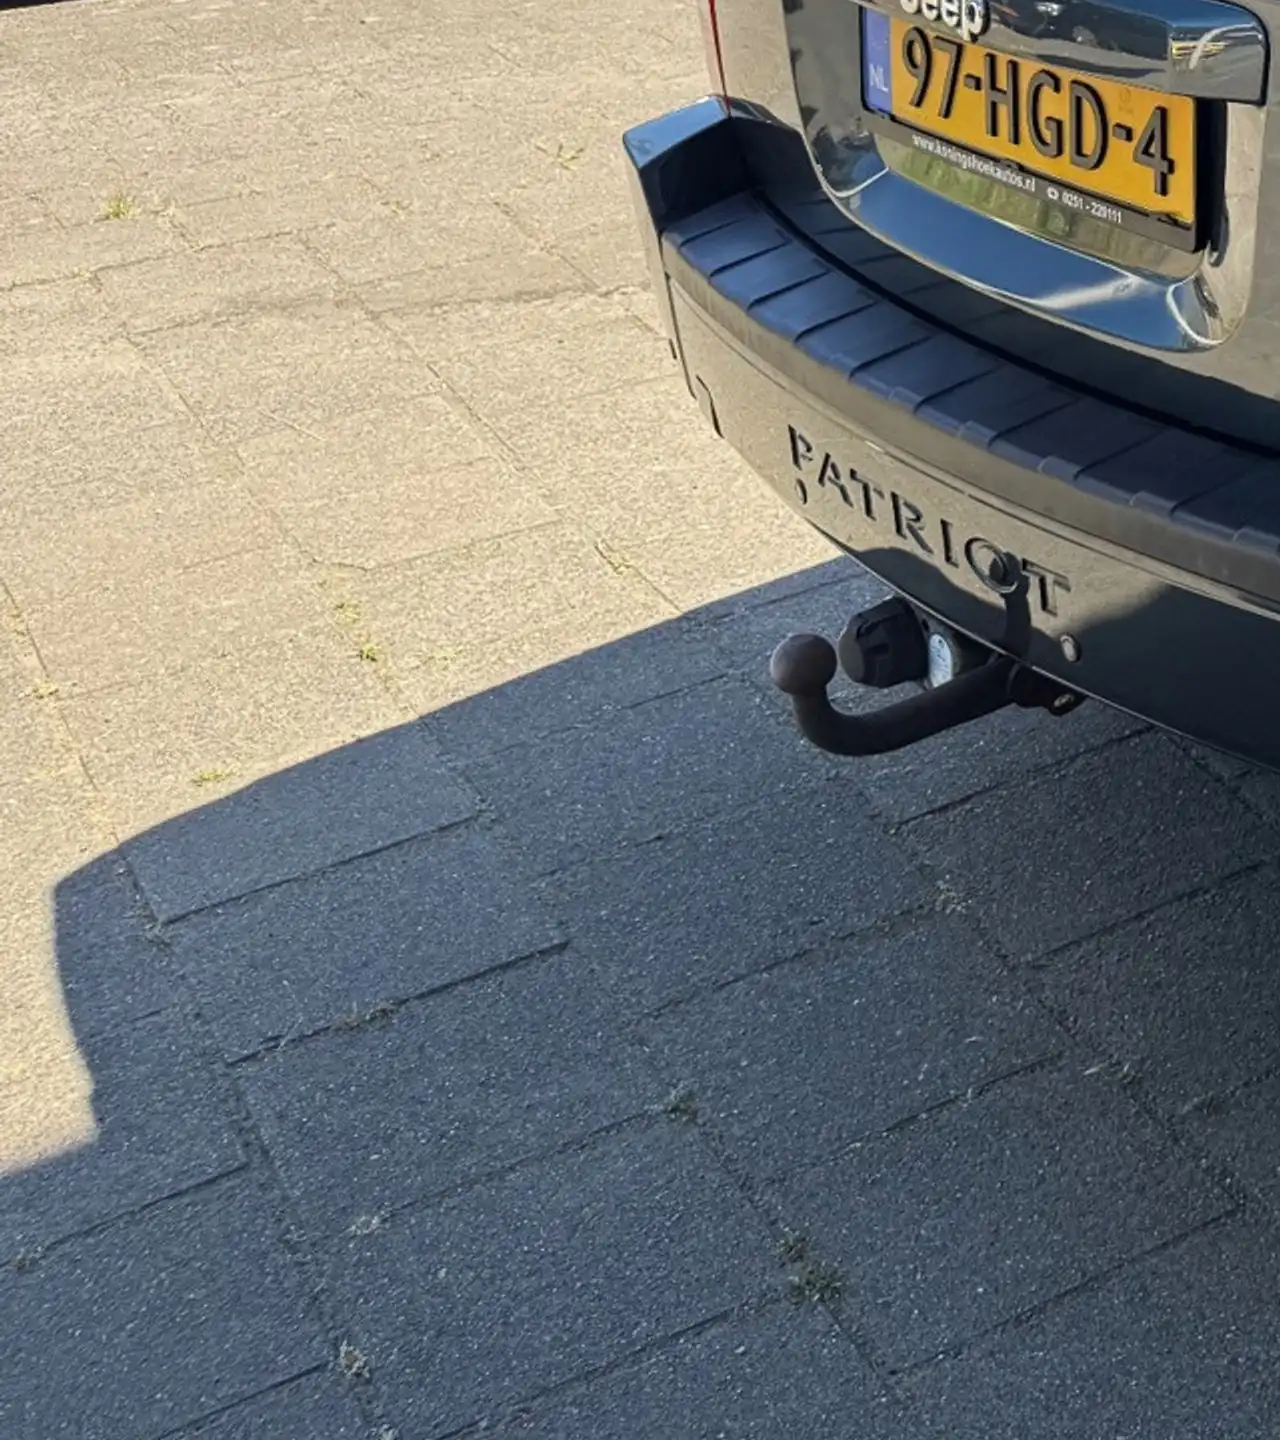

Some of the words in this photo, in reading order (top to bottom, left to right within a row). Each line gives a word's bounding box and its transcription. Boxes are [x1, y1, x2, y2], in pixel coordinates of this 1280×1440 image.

[868, 67, 889, 92] NL
[901, 26, 1176, 197] 97-HGD-4
[787, 423, 1072, 618] PATRIOT
